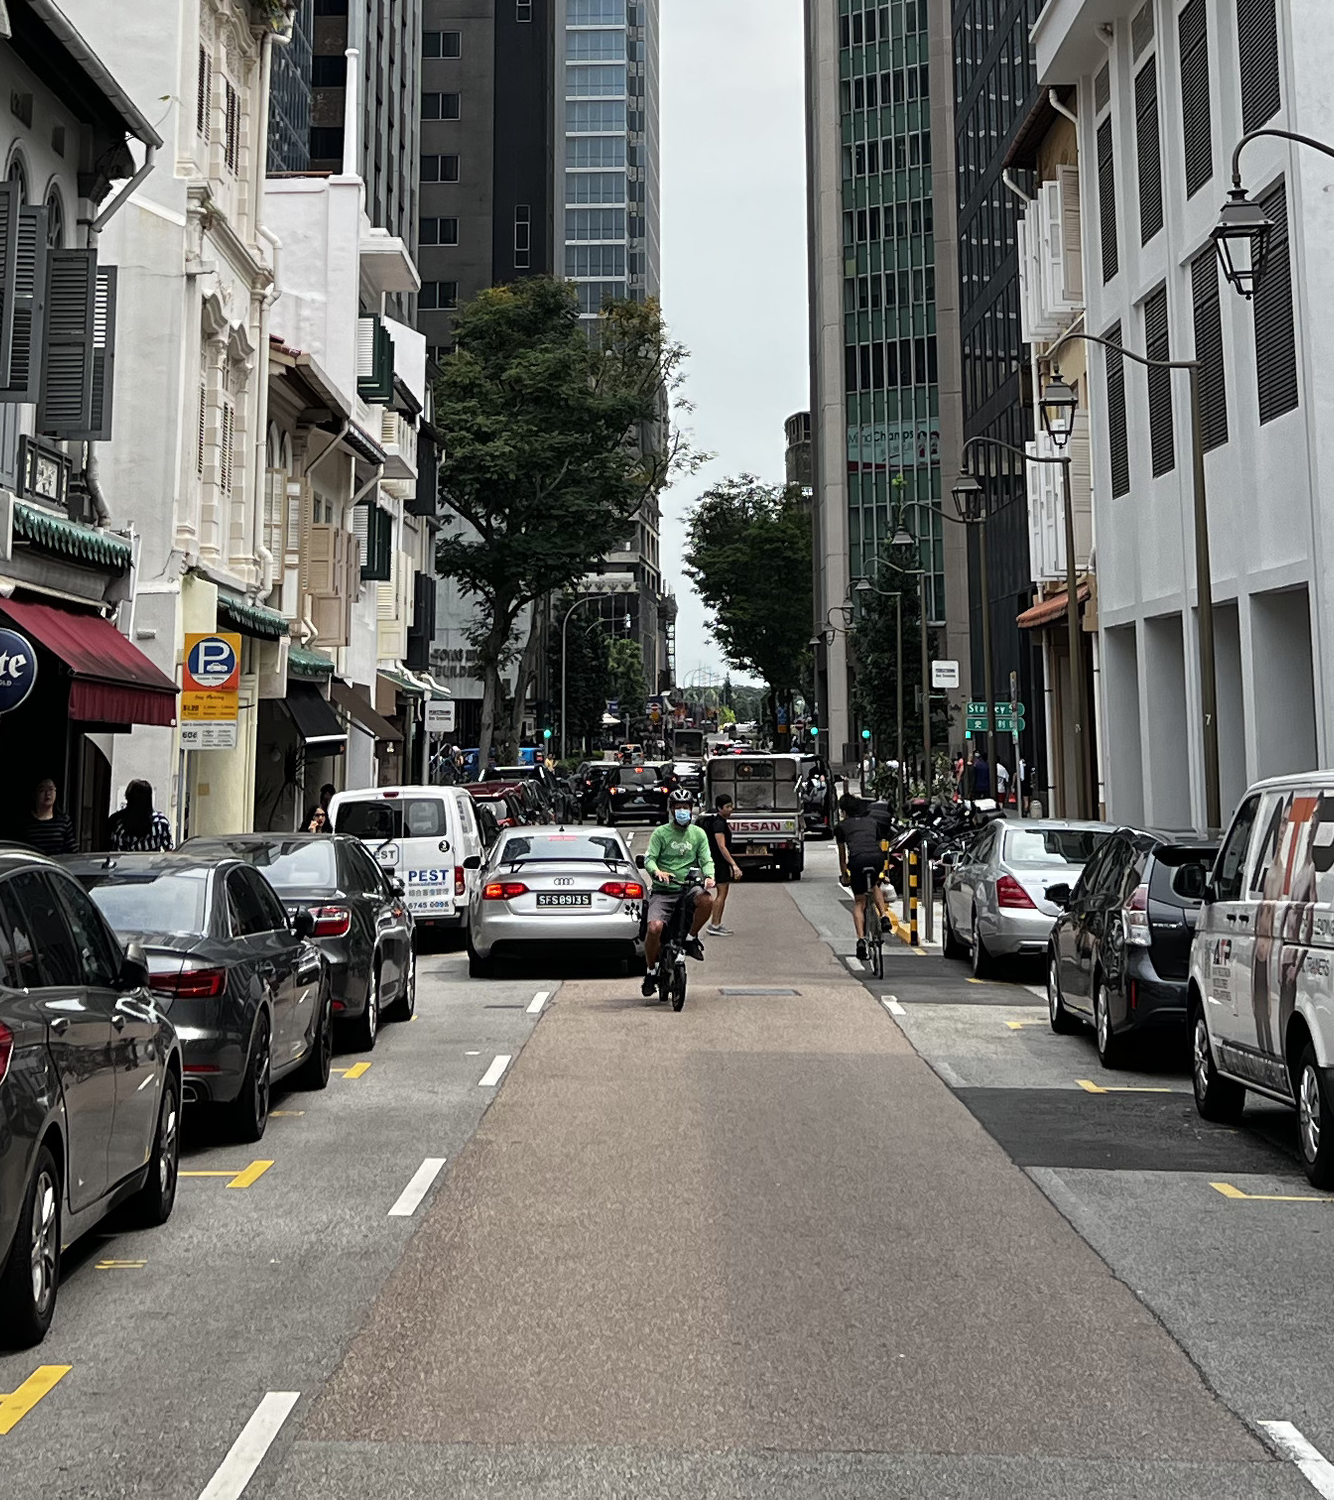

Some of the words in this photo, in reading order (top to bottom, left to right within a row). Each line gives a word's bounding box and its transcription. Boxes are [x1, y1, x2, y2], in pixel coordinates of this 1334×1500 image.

[1205, 713, 1212, 726] 7
[727, 821, 781, 832] NISSAN
[408, 869, 450, 882] PEST
